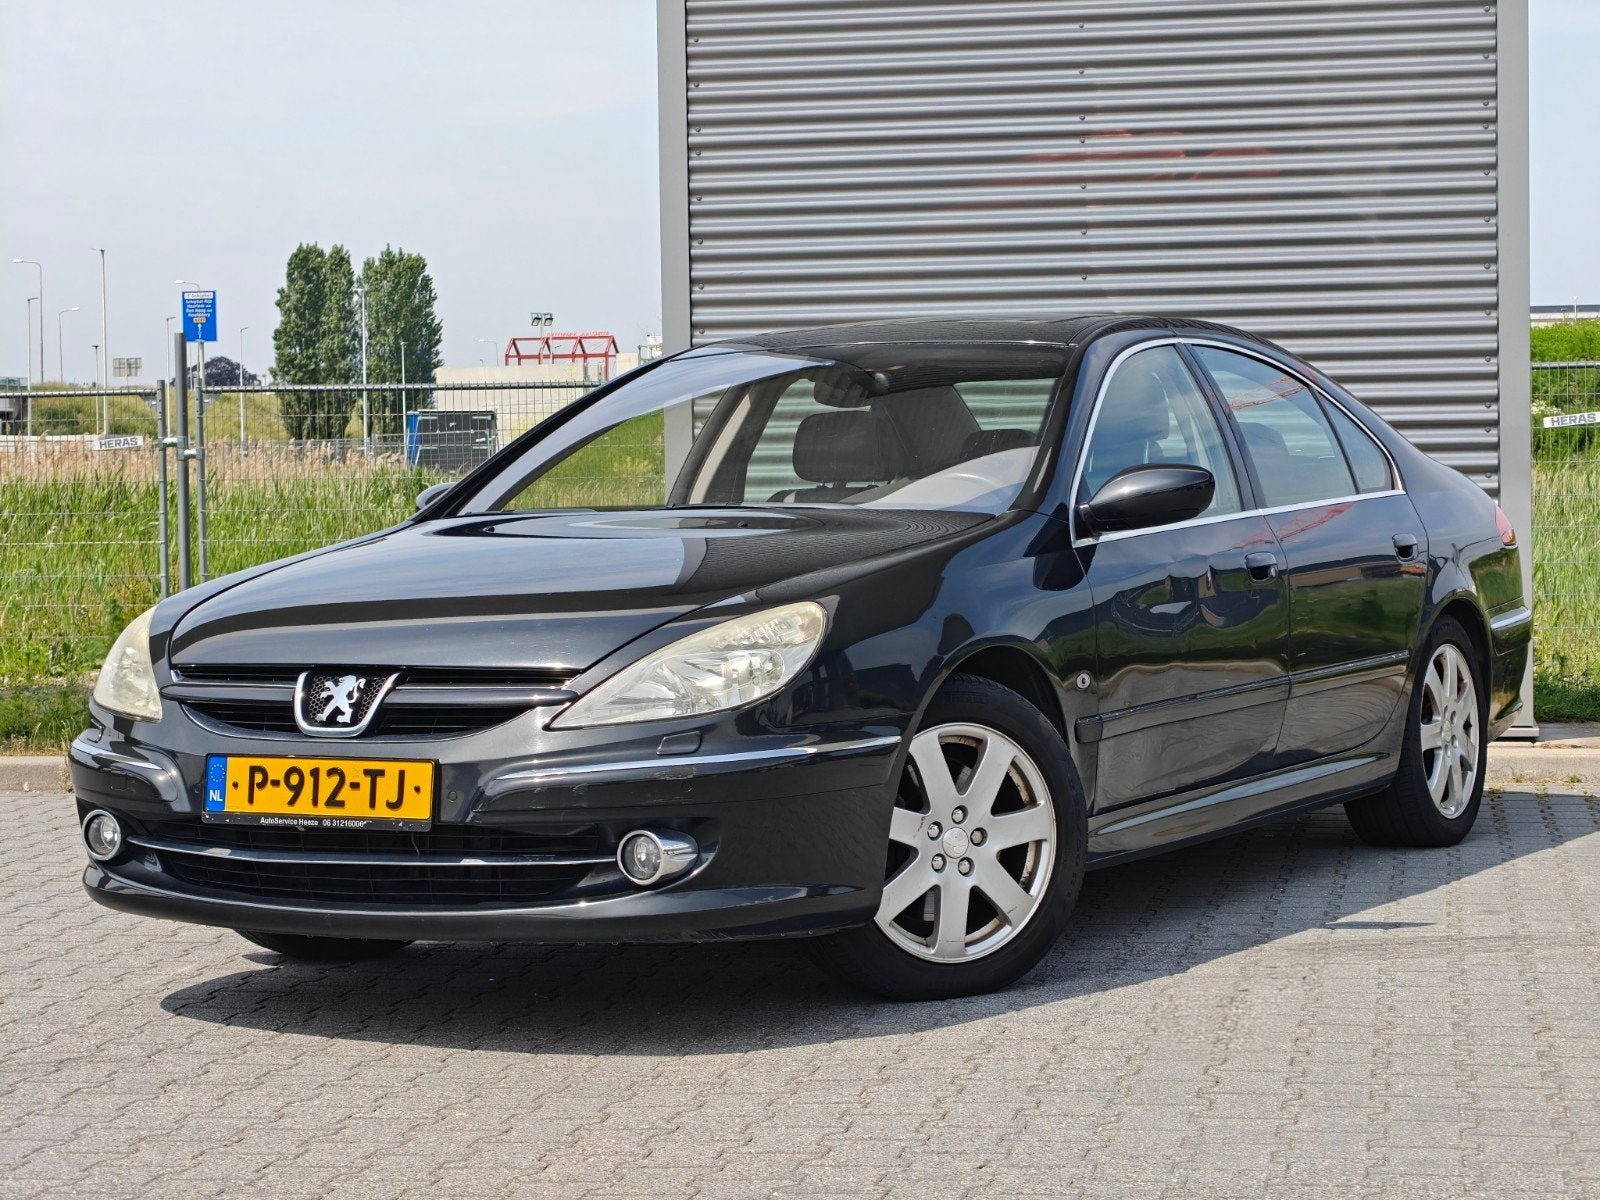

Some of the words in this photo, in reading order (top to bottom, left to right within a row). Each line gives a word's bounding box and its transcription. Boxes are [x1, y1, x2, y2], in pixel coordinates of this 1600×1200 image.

[1551, 413, 1597, 426] HERAS
[99, 437, 138, 449] HERAS
[247, 765, 406, 810] P-912-TJ
[209, 789, 223, 802] NL
[260, 816, 298, 825] AutoService
